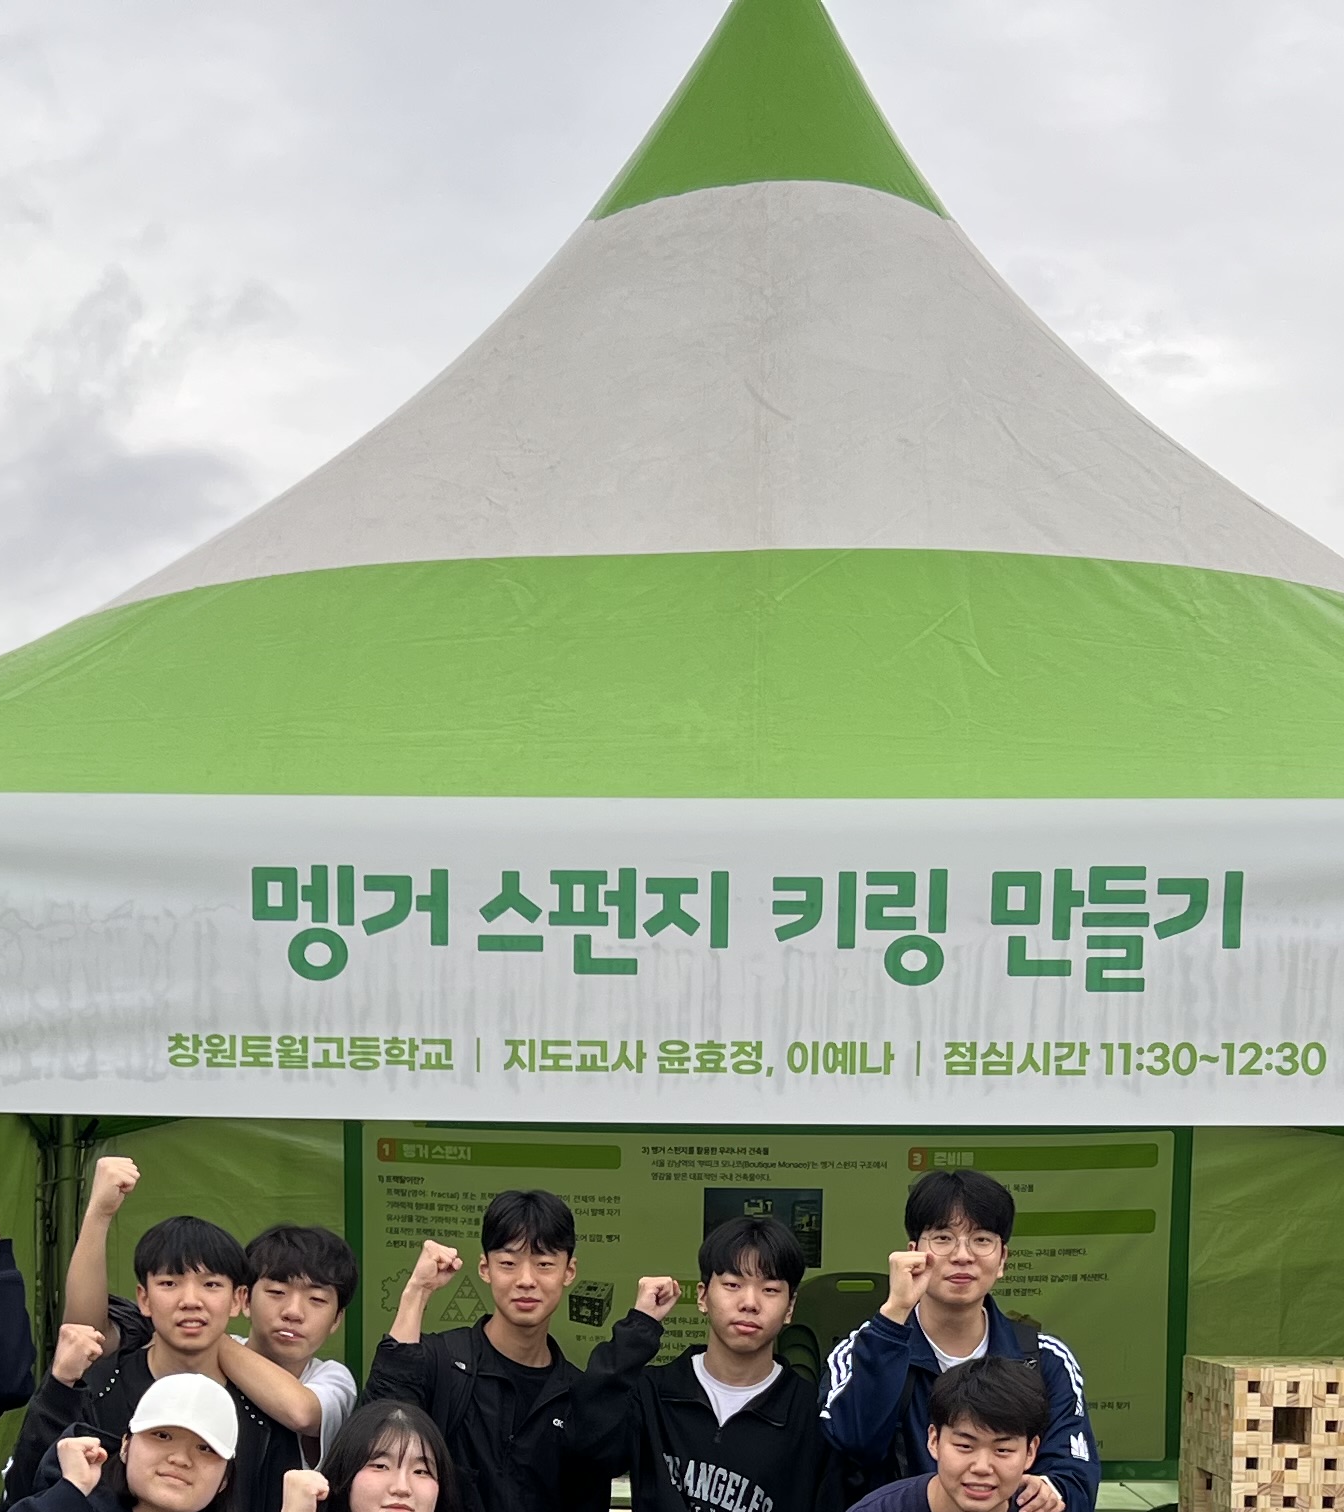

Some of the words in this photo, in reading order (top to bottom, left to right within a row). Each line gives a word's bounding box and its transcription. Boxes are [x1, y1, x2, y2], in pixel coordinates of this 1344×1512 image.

[251, 864, 449, 981] 멩거
[477, 867, 730, 975] 스펀지
[772, 868, 949, 987] 키링
[991, 865, 1244, 994] 만들기
[167, 1032, 454, 1072] 창원토월고등학교
[503, 1037, 647, 1076] 지도교사
[657, 1038, 775, 1079] 윤효정,
[787, 1040, 895, 1076] 이예나
[943, 1040, 1090, 1077] 점심시간
[1100, 1040, 1327, 1076] 11:30~12:30
[381, 1145, 391, 1156] 1
[402, 1145, 429, 1159] 멩거
[431, 1146, 471, 1161] 스펀지
[667, 1147, 694, 1155] 스펀지를
[912, 1153, 922, 1165] 3
[933, 1151, 974, 1166] 준비물
